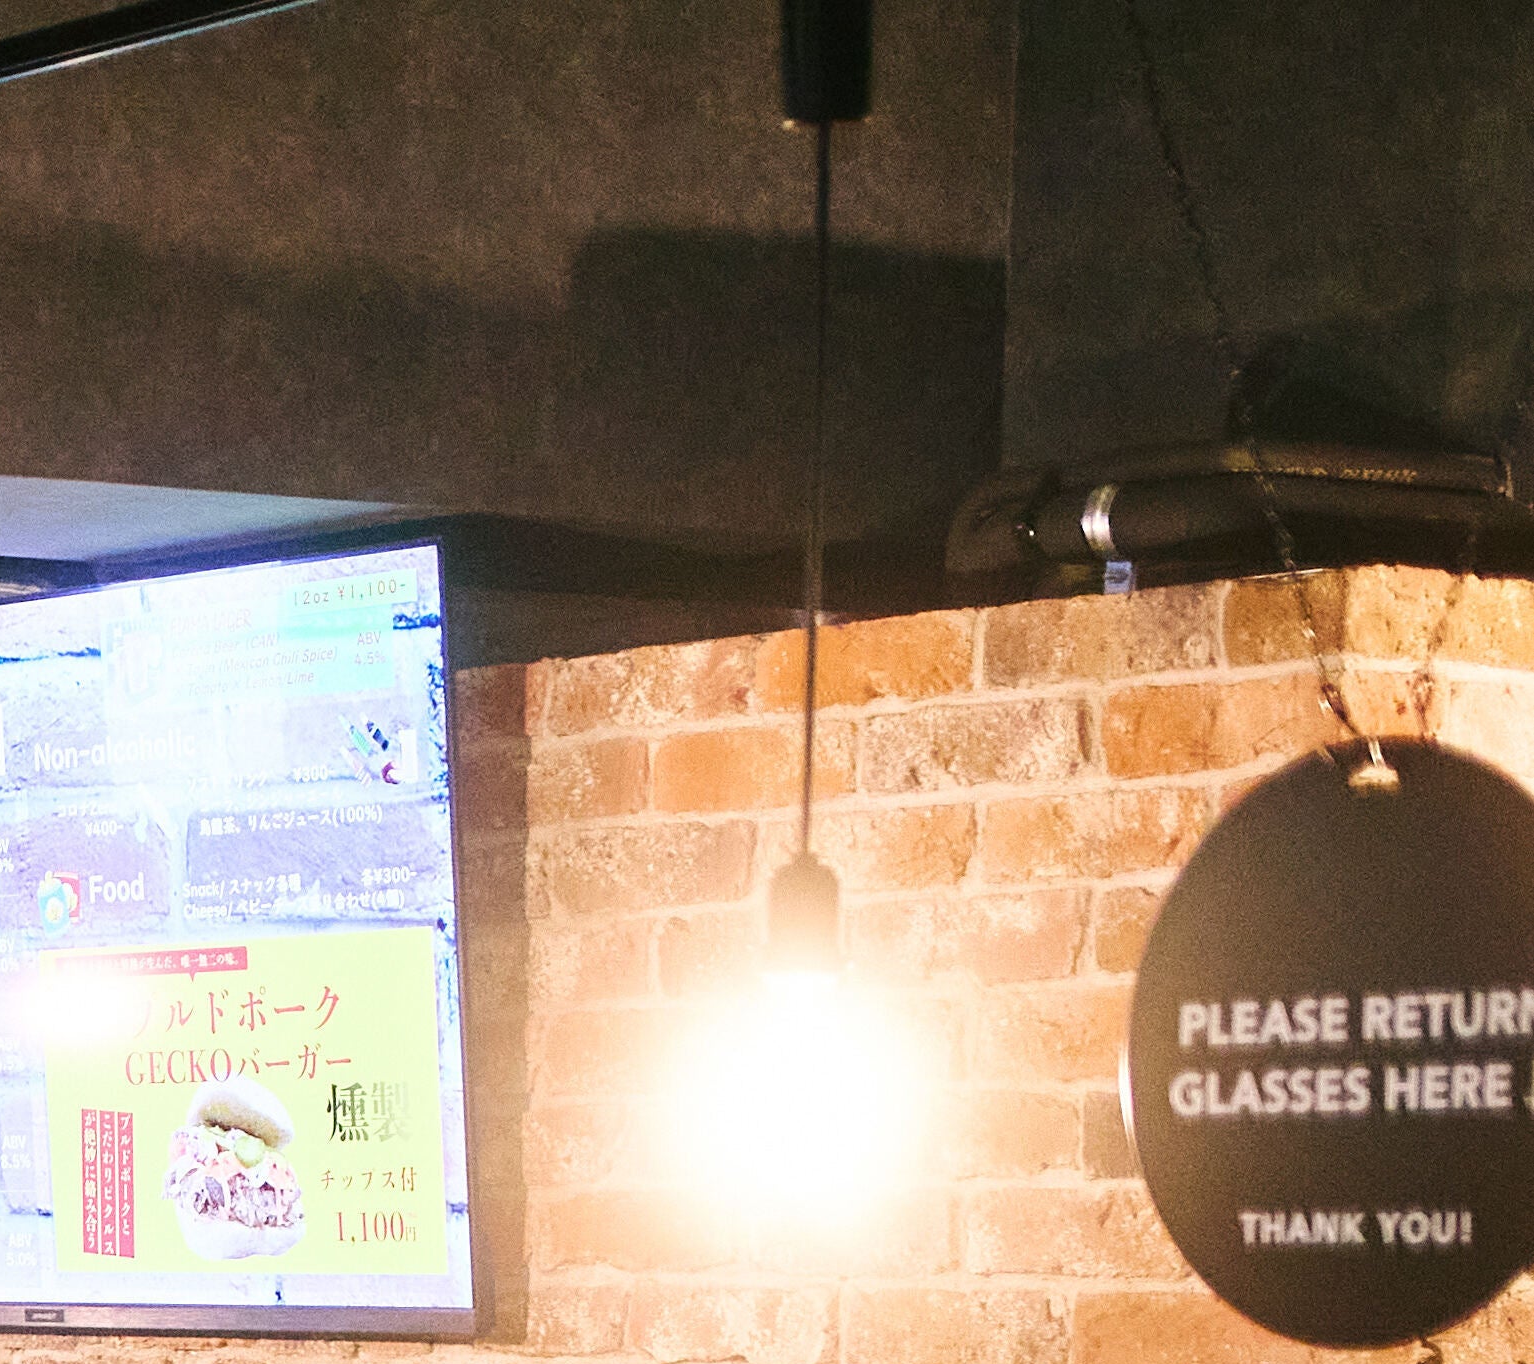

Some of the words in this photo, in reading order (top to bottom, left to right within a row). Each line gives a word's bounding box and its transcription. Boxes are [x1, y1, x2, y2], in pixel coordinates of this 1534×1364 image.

[293, 589, 329, 607] 12oz
[357, 630, 383, 647] ABV
[273, 651, 299, 667] Chili
[302, 646, 338, 664] Spice)
[353, 652, 387, 667] 4.5%
[34, 727, 196, 772] Non-alcoholic
[88, 872, 146, 904] Food
[183, 881, 224, 898] Snack/
[1178, 999, 1348, 1047] PLEASE
[124, 1042, 353, 1086] GECKOバーガー
[1168, 1066, 1371, 1119] GLASSES
[1384, 1062, 1513, 1114] HERE
[1, 1135, 27, 1150] ABV
[1238, 1210, 1366, 1247] THANK
[1377, 1210, 1473, 1247] YOU!
[8, 1234, 33, 1248] ABV
